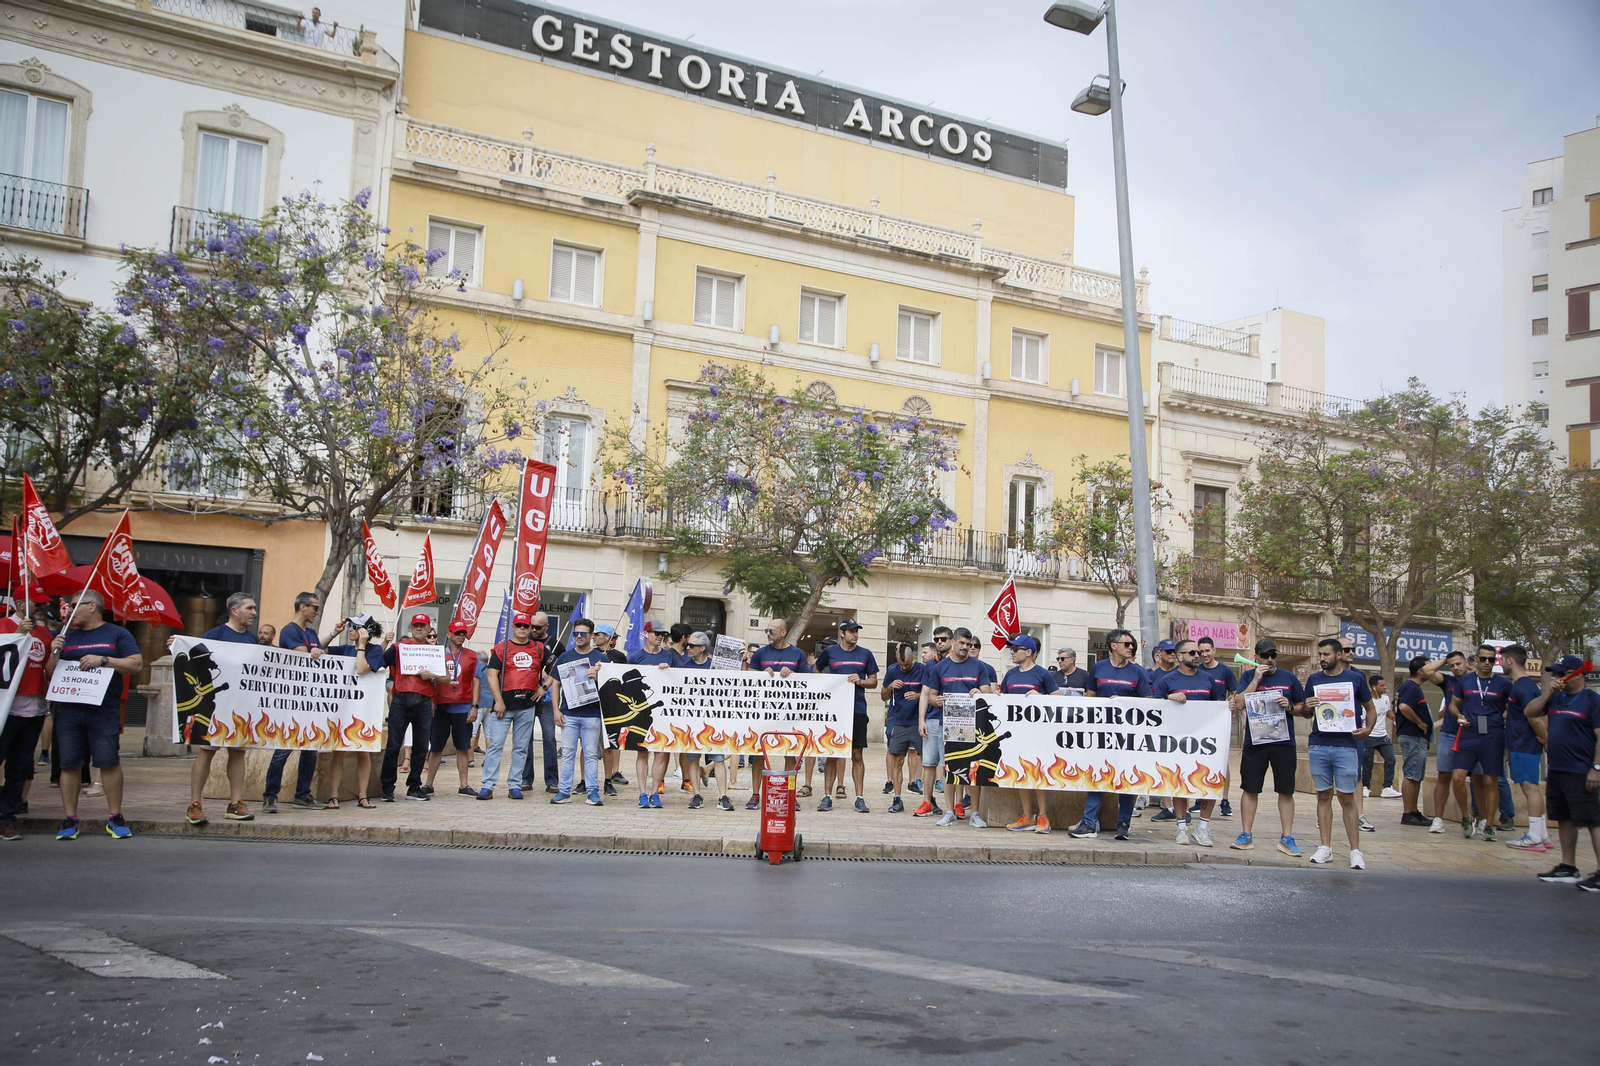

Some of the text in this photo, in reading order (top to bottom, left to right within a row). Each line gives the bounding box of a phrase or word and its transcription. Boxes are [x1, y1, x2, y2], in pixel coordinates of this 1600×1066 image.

[531, 12, 994, 162] GESTORIA ARCOS
[525, 474, 550, 565] UGT
[112, 537, 139, 584] UGT
[474, 514, 501, 591] UGT
[518, 577, 539, 593] UGT
[538, 603, 574, 613] ALE-HOP
[1190, 626, 1236, 640] BAO NAILS
[1344, 632, 1367, 645] SE
[1280, 645, 1311, 654] UNIVERSAL
[263, 650, 344, 671] SIN INVERSIÓN
[71, 676, 99, 685] HORAS
[241, 663, 360, 686] NO SE PUEDE DAR UN
[51, 685, 70, 695] UGT
[239, 679, 365, 700] SERVICIO DE CALIDAD
[683, 676, 807, 690] LAS INSTALACIONES
[662, 685, 832, 701] DEL PARQUE DE BOMBEROS
[258, 696, 339, 713] AL CIUDADANO
[671, 697, 819, 711] SON LA VERGÜENZA DEL
[659, 707, 838, 722] AYUNTAMIENTO DE ALMERÍA
[1006, 704, 1163, 727] BOMBEROS
[1055, 730, 1217, 756] QUEMADOS
